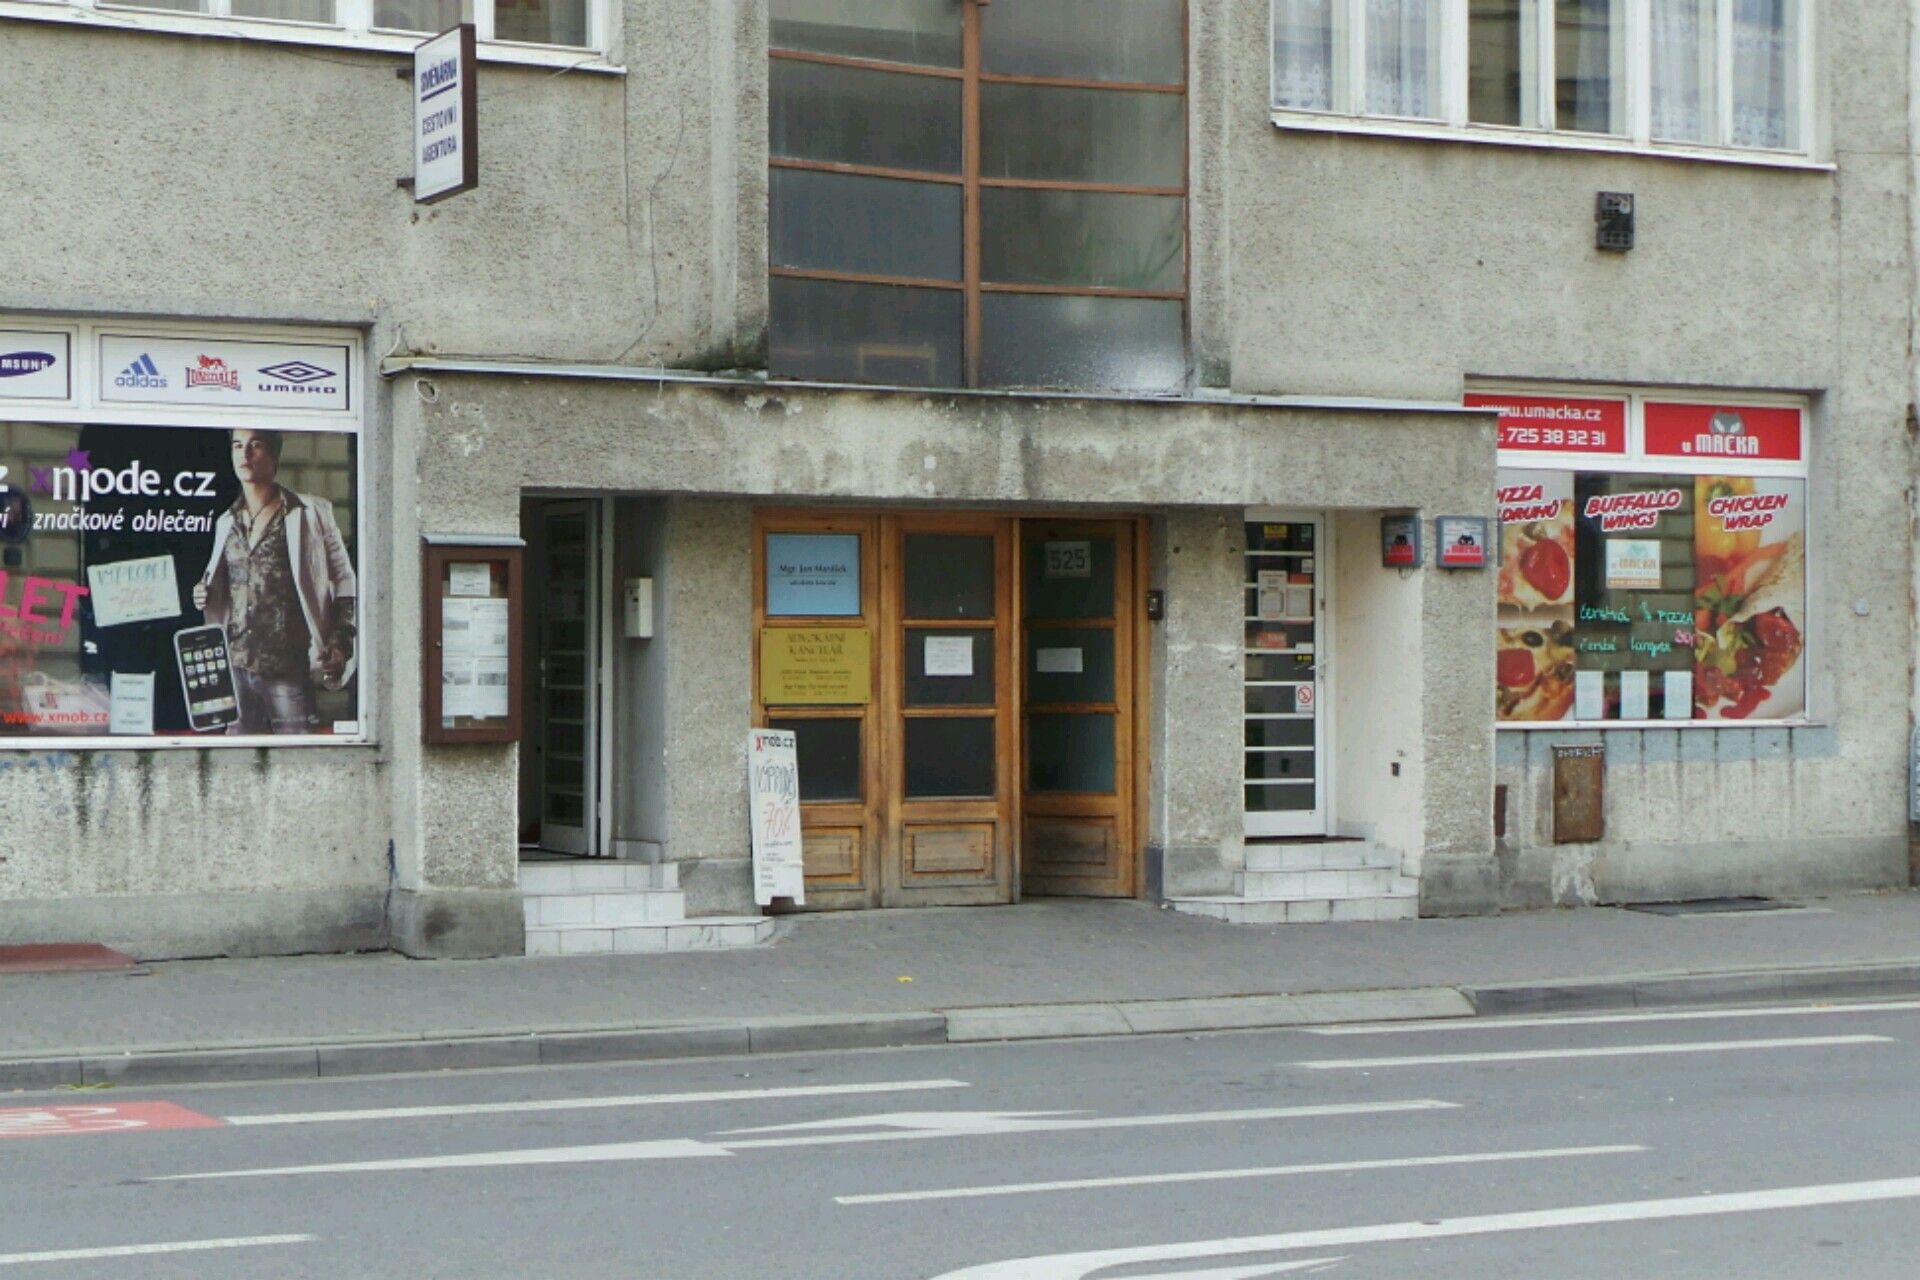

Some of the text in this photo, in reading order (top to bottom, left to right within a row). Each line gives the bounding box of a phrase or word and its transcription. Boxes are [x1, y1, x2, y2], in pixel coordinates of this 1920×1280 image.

[421, 57, 457, 92] SMĚNÁRNA
[422, 101, 457, 135] CESTOVNÍ
[422, 134, 457, 164] AGENTURA
[115, 376, 168, 388] adidas
[185, 367, 241, 391] LONSDALE
[1507, 427, 1606, 446] 725 38 32 31
[1586, 491, 1680, 514] BUFFALLO
[1709, 494, 1788, 515] CHICKEN
[33, 506, 214, 532] značkové oblečení
[1602, 512, 1658, 530] WINGS
[1724, 513, 1774, 530] WRAP
[1050, 548, 1086, 570] 525
[3, 710, 109, 723] www.xmob.cz
